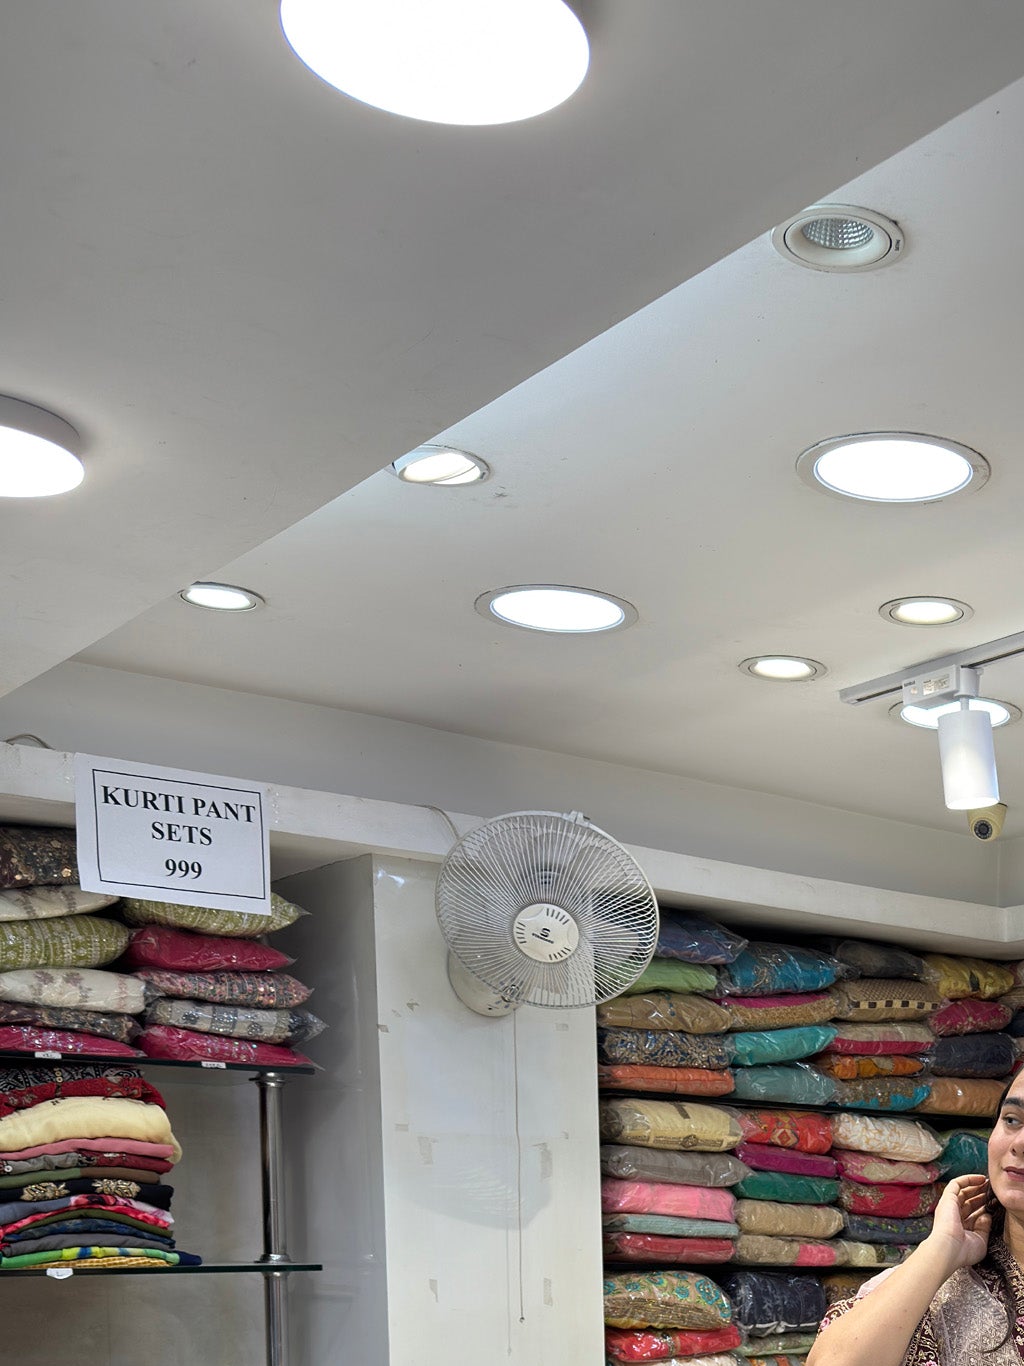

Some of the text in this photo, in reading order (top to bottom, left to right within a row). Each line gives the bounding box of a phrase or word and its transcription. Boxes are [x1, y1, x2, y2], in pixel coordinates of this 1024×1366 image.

[100, 785, 256, 823] KURTI PANT
[151, 821, 213, 846] SETS
[164, 858, 203, 880] 999
